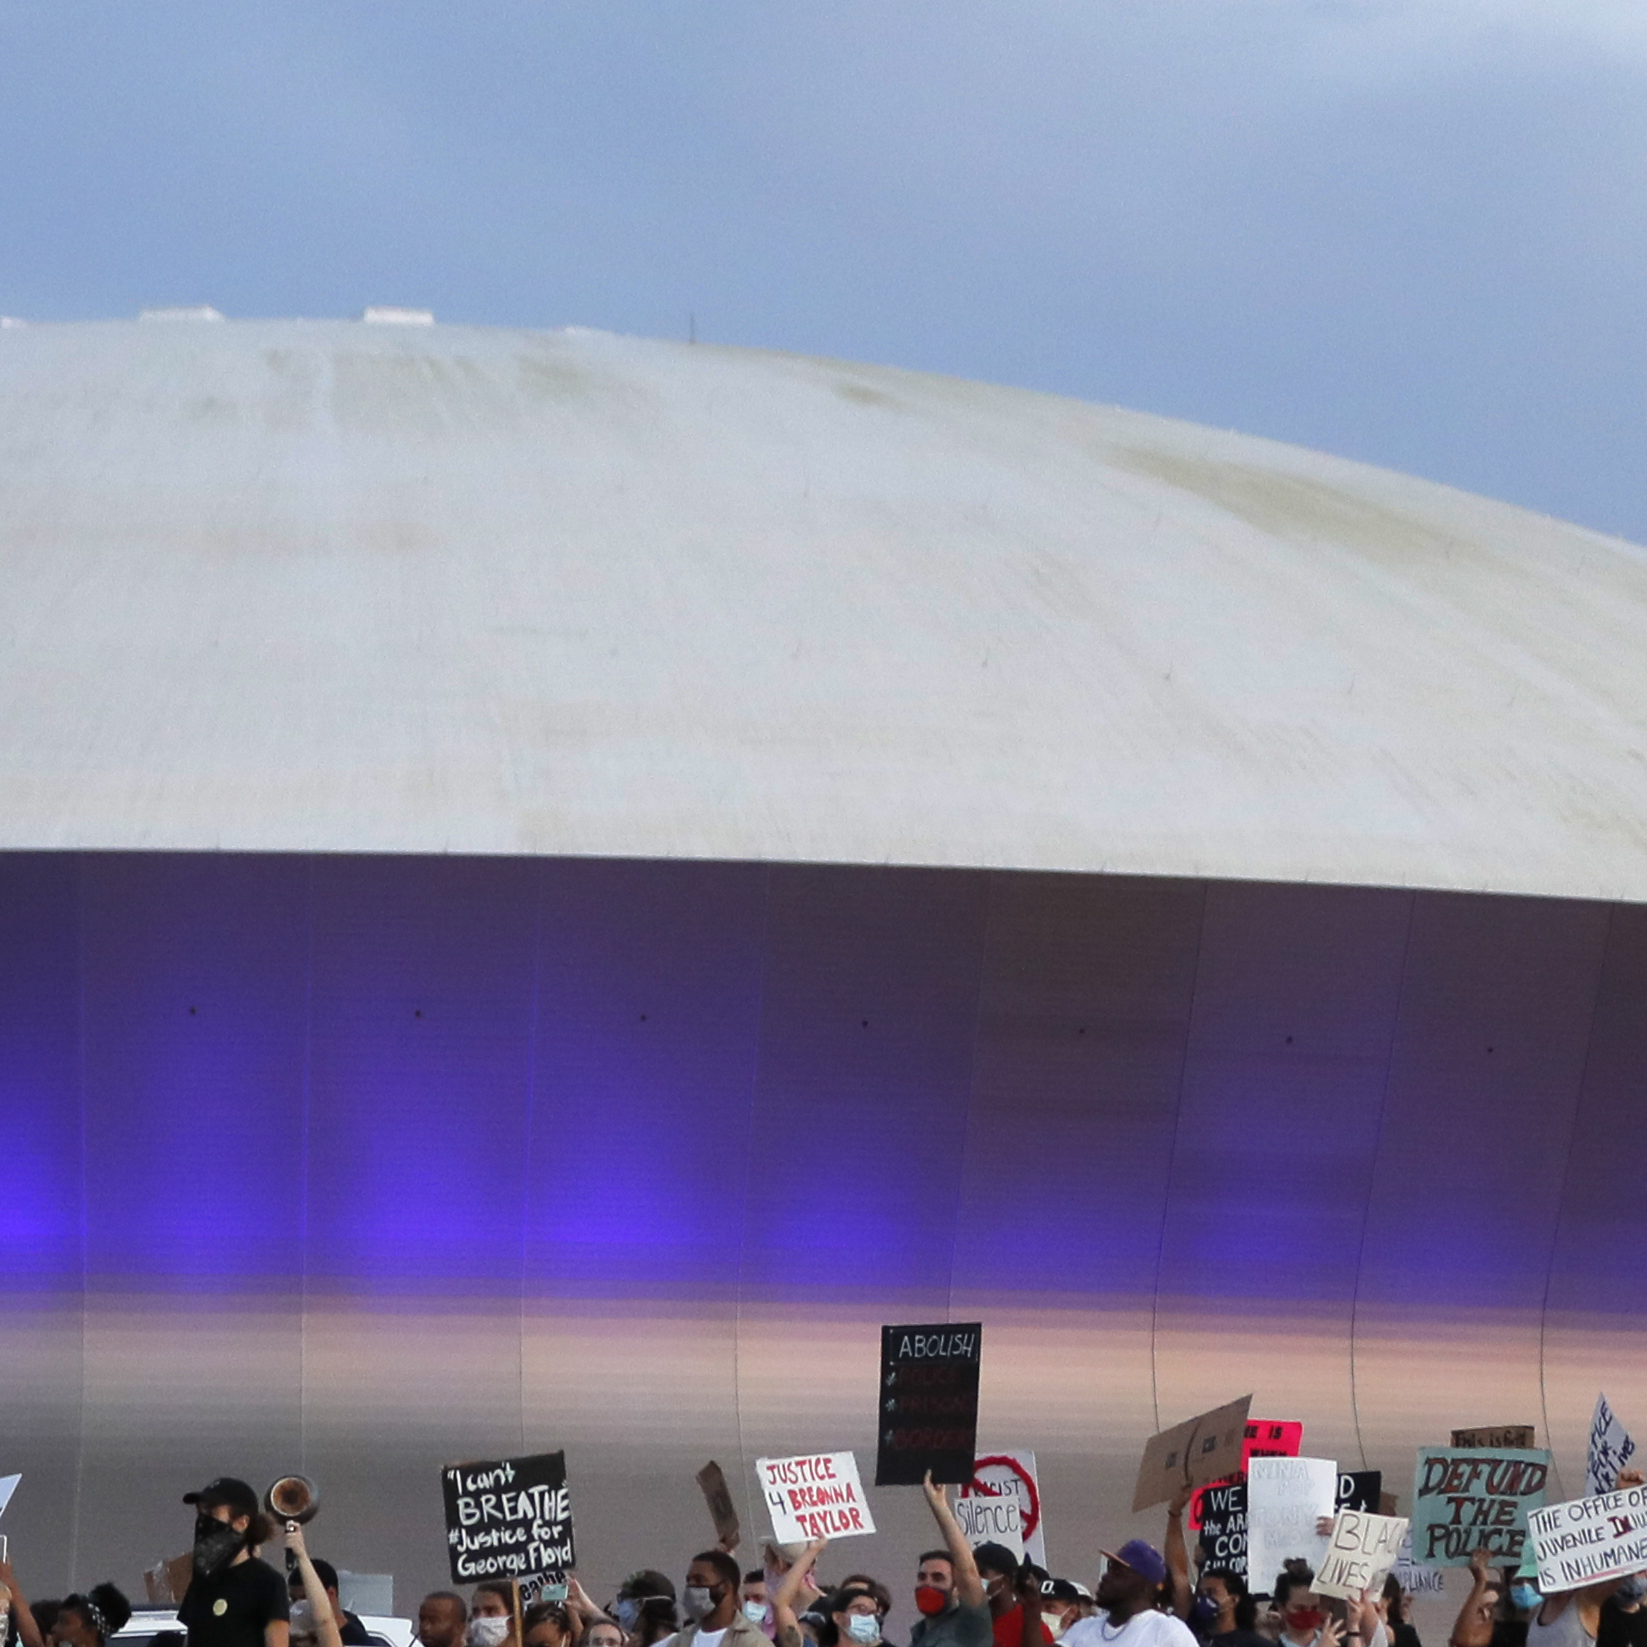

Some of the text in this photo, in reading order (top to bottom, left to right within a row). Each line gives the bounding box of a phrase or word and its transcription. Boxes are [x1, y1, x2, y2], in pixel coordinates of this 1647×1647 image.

[897, 1333, 975, 1358] ABOLISH
[766, 1457, 837, 1485] JUSTICE
[1418, 1456, 1548, 1500] DEFUND
[769, 1481, 857, 1515] 4 BREONNA
[1210, 1486, 1243, 1512] WE
[1446, 1497, 1518, 1526] THE
[532, 1519, 563, 1540] for
[795, 1507, 864, 1537] TAYLOR
[957, 1500, 1019, 1536] Silence
[1529, 1508, 1563, 1536] THE
[1568, 1495, 1622, 1521] OFFICE
[457, 1538, 572, 1577] George Floyd
[1425, 1523, 1526, 1560] POLICE
[1538, 1527, 1605, 1561] JUVENILE
[1316, 1554, 1370, 1588] LIVES
[1539, 1569, 1556, 1587] IS
